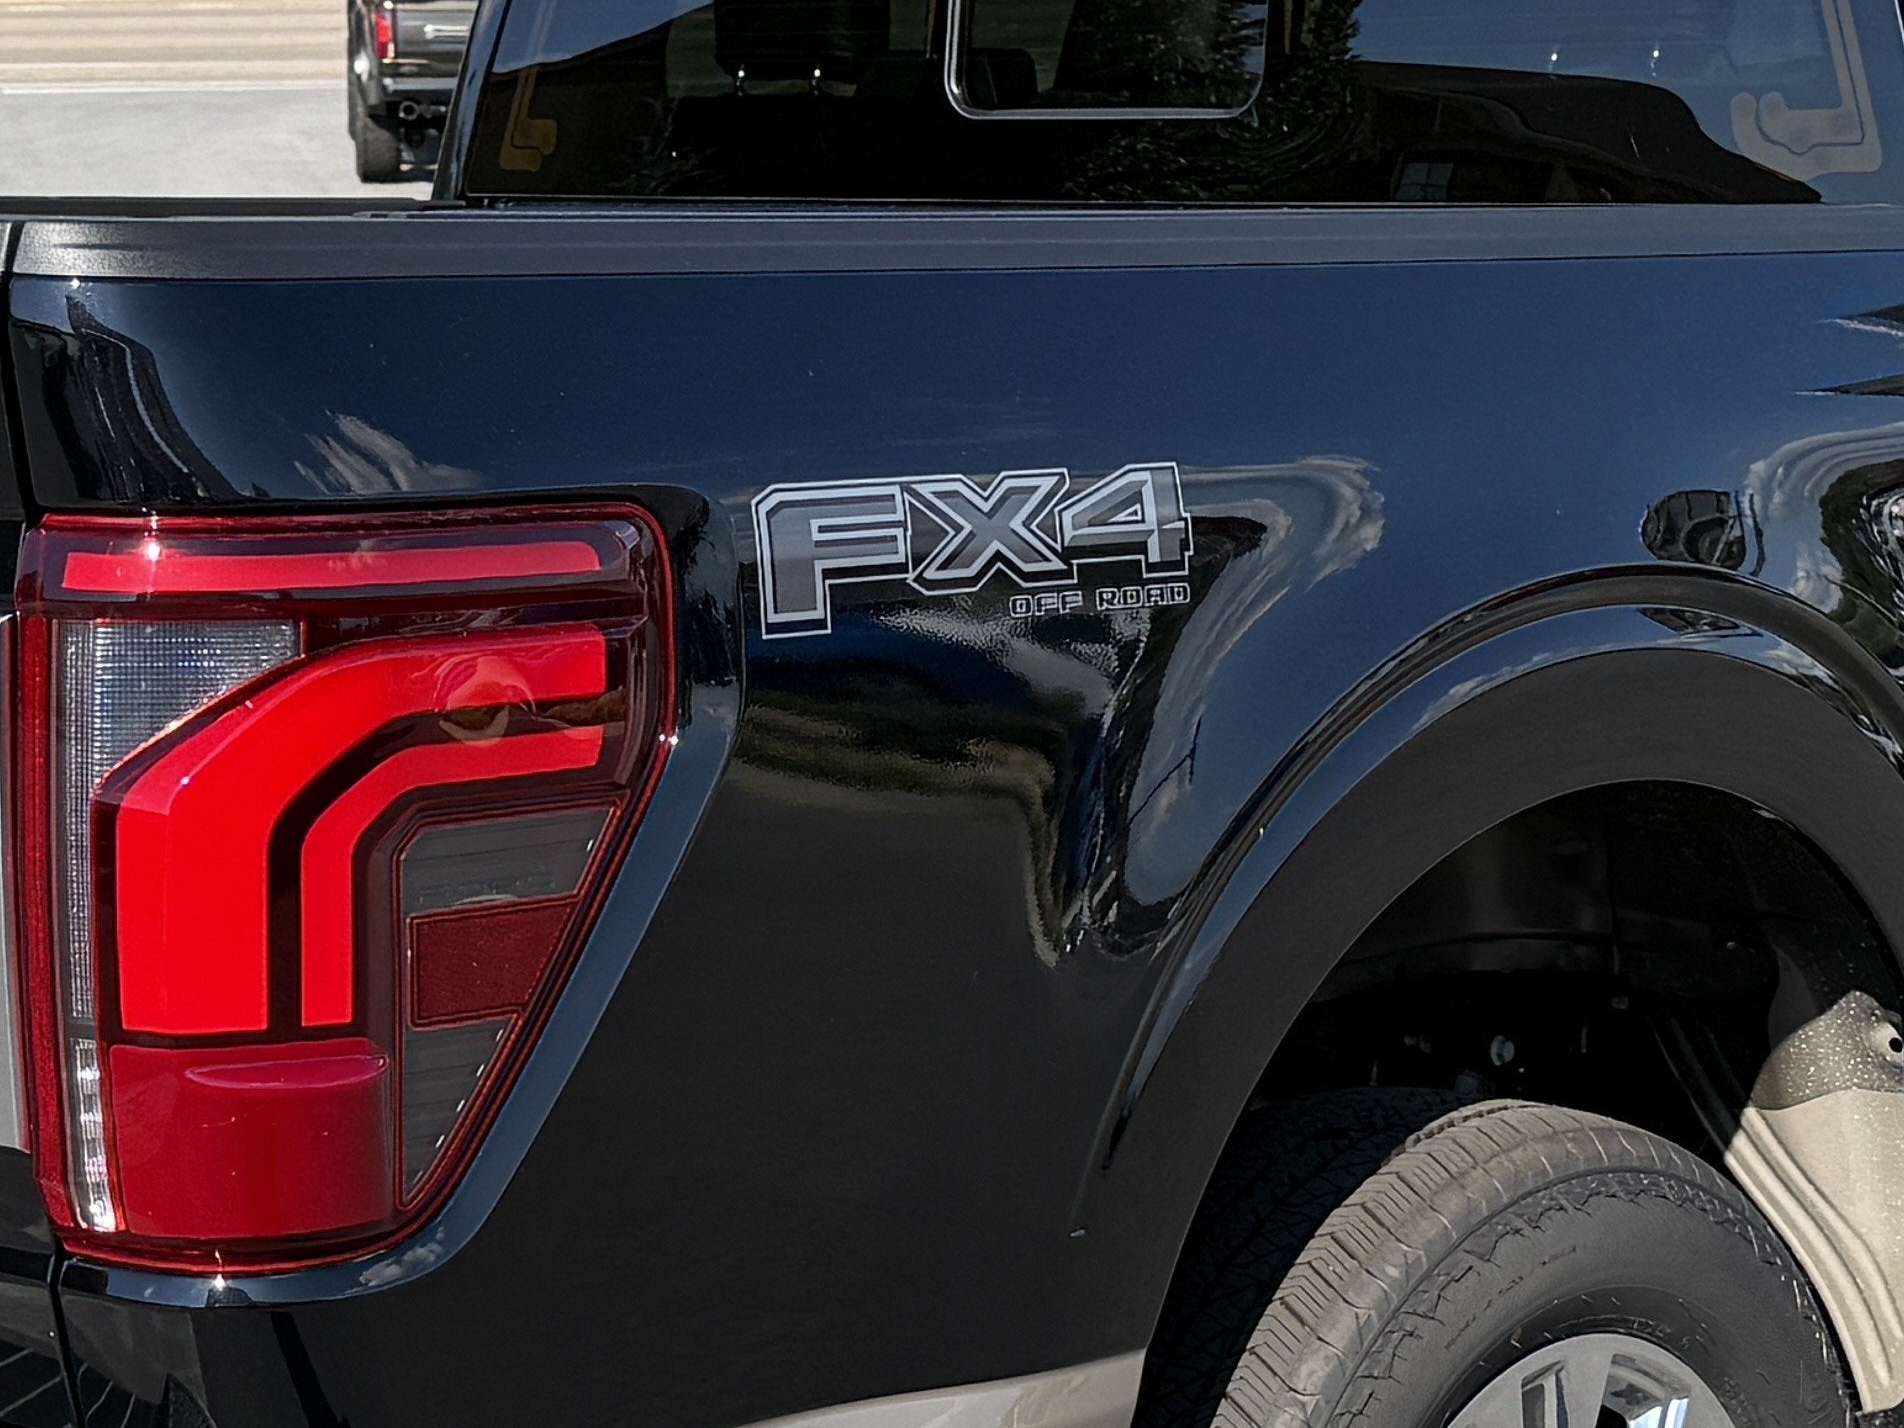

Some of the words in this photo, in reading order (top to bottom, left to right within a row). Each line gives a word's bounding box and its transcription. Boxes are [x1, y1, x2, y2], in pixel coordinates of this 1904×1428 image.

[751, 461, 1194, 639] FX4
[1009, 591, 1084, 618] OFF
[1095, 582, 1191, 612] ROAD
